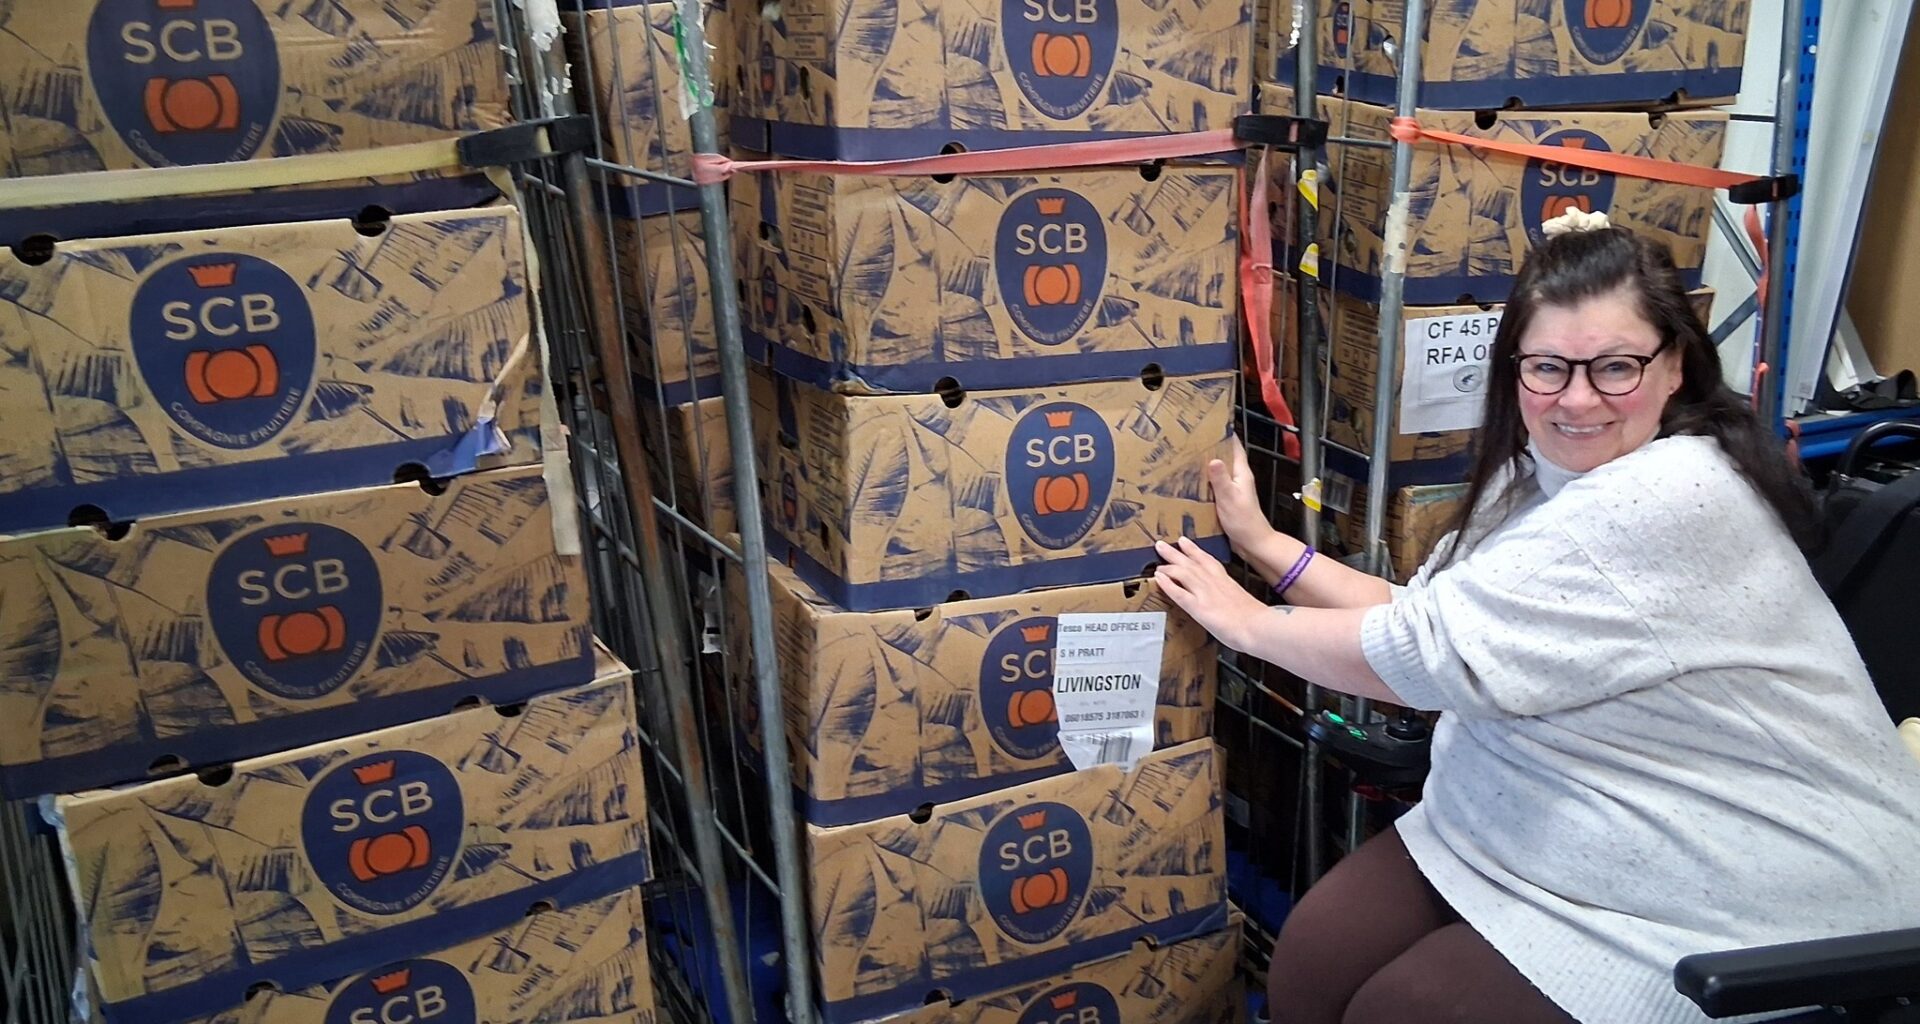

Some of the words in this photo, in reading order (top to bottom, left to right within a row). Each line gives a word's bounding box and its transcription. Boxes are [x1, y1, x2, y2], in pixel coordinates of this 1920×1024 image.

[1024, 0, 1098, 23] SCB
[121, 19, 243, 64] SCB
[1016, 223, 1088, 256] SCB
[162, 293, 280, 341] SCB
[1428, 321, 1453, 339] CF
[1460, 319, 1481, 336] 45
[1426, 346, 1466, 365] RFA
[1026, 434, 1096, 468] SCB
[238, 558, 349, 606] SCB
[1058, 623, 1082, 633] Tesco
[1085, 623, 1108, 632] HEAD
[1111, 622, 1139, 632] OFFICE
[1000, 647, 1057, 682] SC
[1078, 648, 1106, 657] PRATT
[1057, 674, 1142, 693] LIVINGSTON
[330, 781, 433, 833] SCB
[1000, 829, 1072, 871] SCB
[350, 985, 447, 1024] SCB
